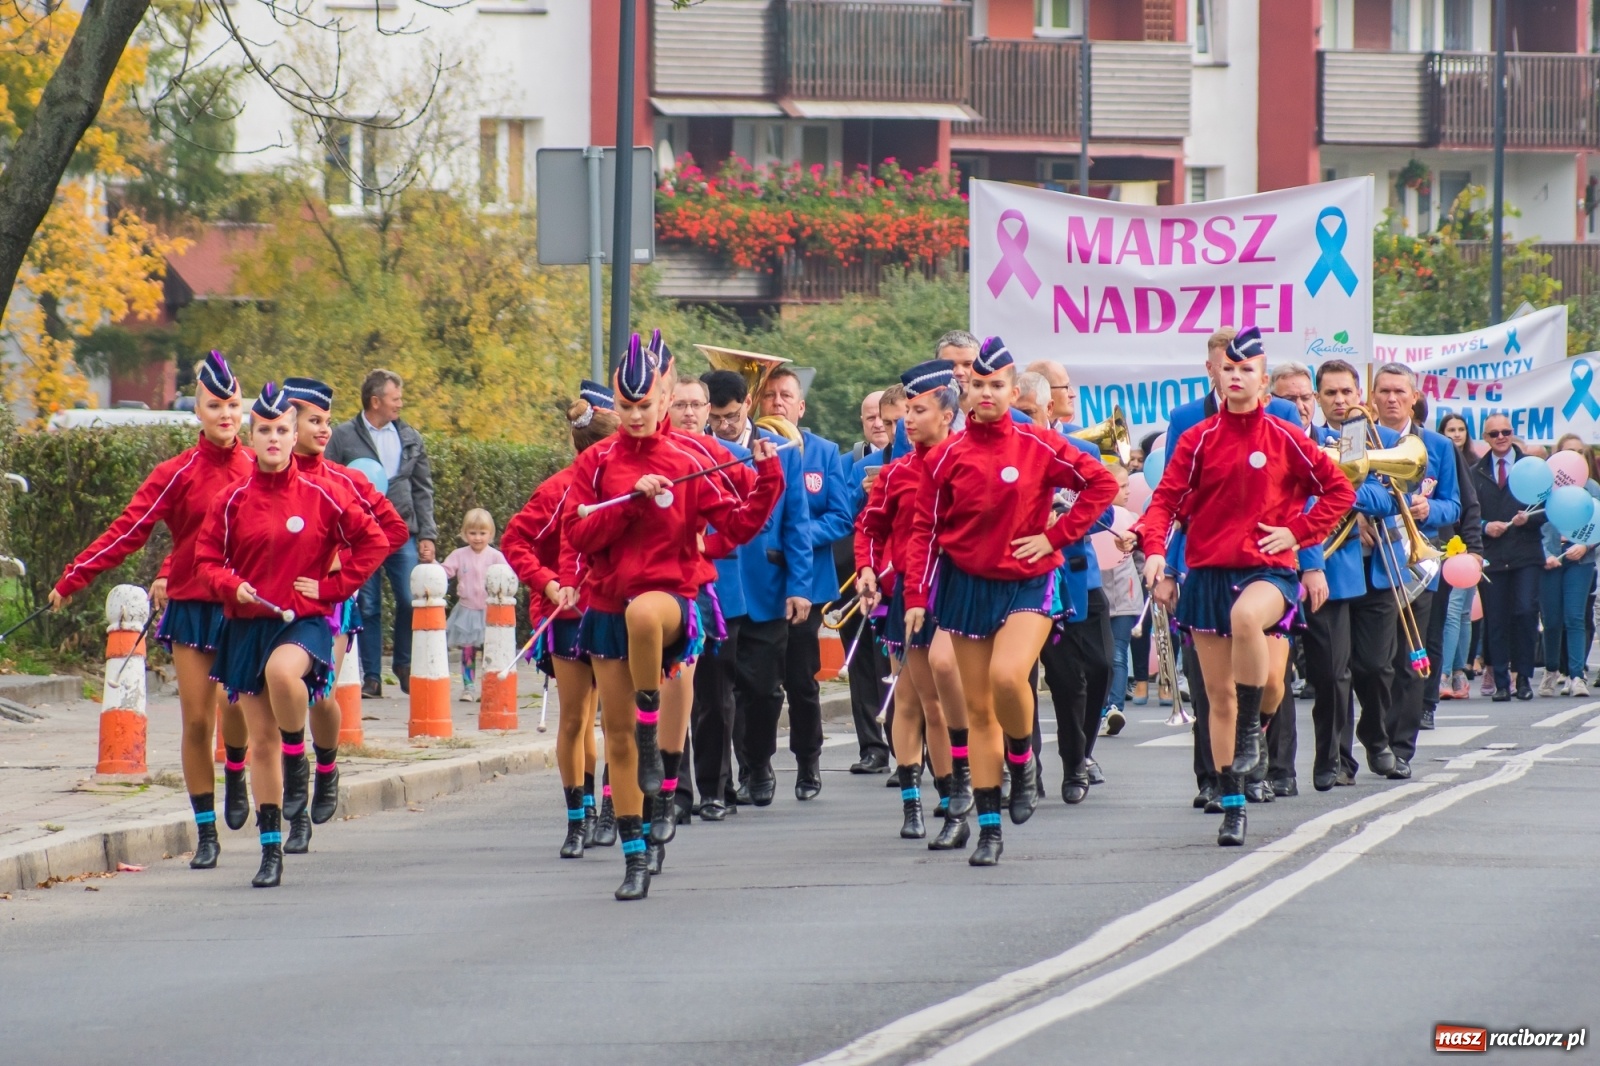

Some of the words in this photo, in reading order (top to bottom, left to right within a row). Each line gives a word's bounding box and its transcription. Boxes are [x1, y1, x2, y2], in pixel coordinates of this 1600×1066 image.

[1067, 214, 1278, 265] MARSZ
[1053, 283, 1294, 334] NADZIEI
[1406, 346, 1433, 363] NIE
[1441, 336, 1489, 357] MYŚL
[1456, 357, 1534, 379] DOTYCZY
[1436, 406, 1555, 440] RAKEM
